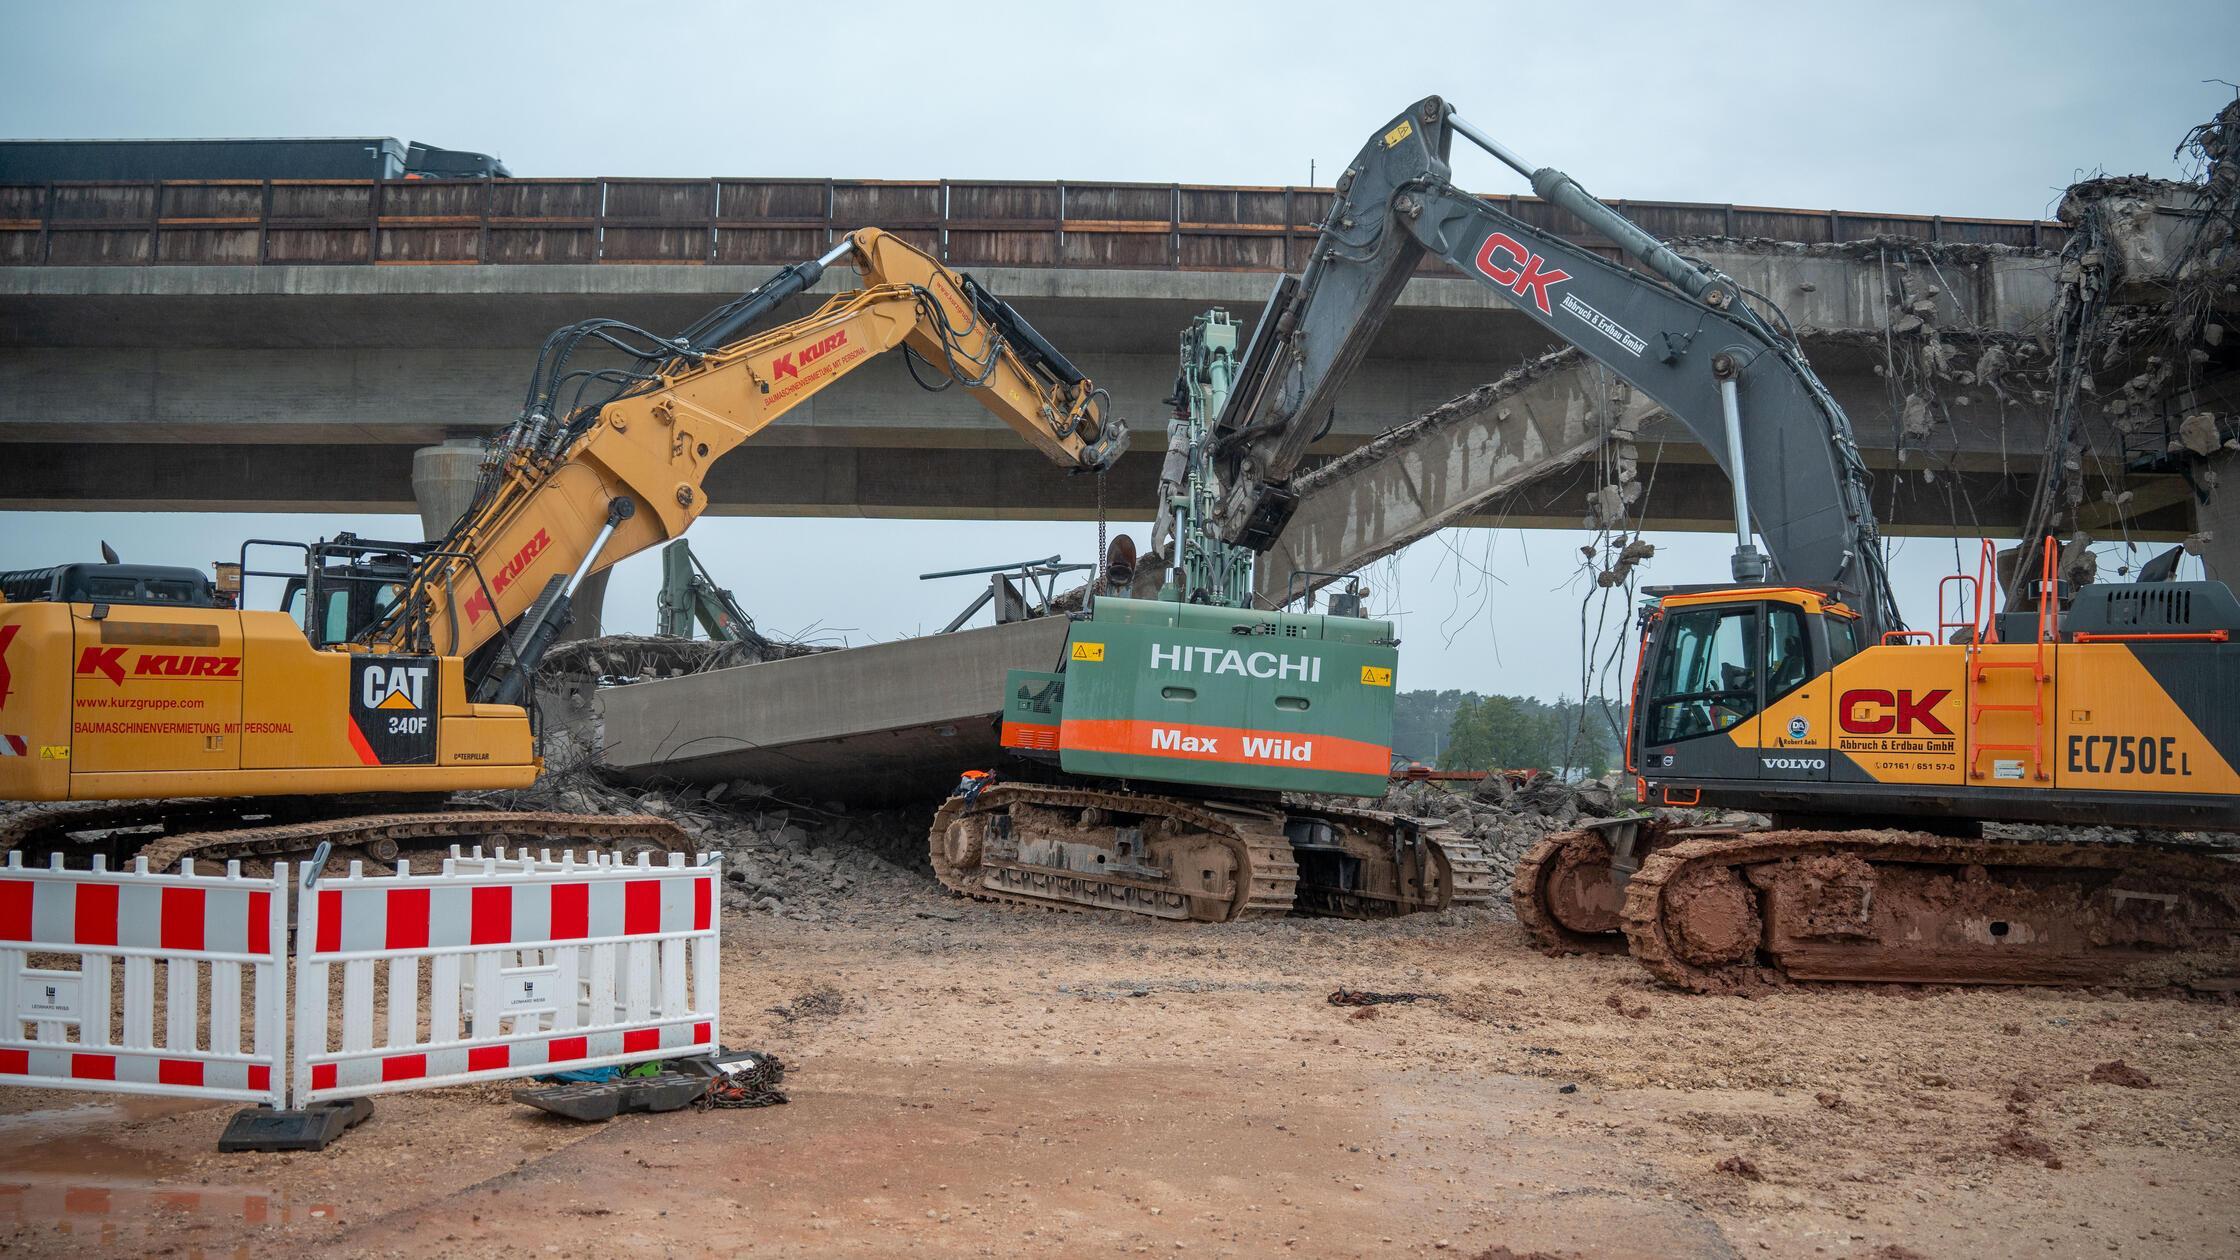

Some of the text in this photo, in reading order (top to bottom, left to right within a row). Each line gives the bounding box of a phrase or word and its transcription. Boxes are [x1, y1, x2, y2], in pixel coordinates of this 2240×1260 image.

[1475, 232, 1573, 316] CK
[1562, 295, 1646, 354] Abbruch & Erdbau GmbH
[773, 329, 848, 381] K KURZ
[833, 358, 842, 370] MIT
[841, 346, 867, 365] PERSONAL
[492, 527, 551, 595] KURZ
[76, 647, 242, 687] K KURZ
[1150, 643, 1321, 683] HITACHI
[76, 697, 205, 711] www.kurzgruppe.com
[363, 665, 429, 710] CAT
[74, 722, 293, 734] BAUMASCHINENVERMIETUNG MIT PERSONAL
[388, 717, 427, 734] 340F
[1839, 689, 1955, 735] CK
[453, 753, 490, 761] CATERPILLAR
[1151, 728, 1312, 762] Max Wild
[1840, 740, 1954, 752] Abbruch & Erdbau GmbH
[1762, 758, 1826, 769] VOLVO
[1936, 763, 1955, 771] 57-0
